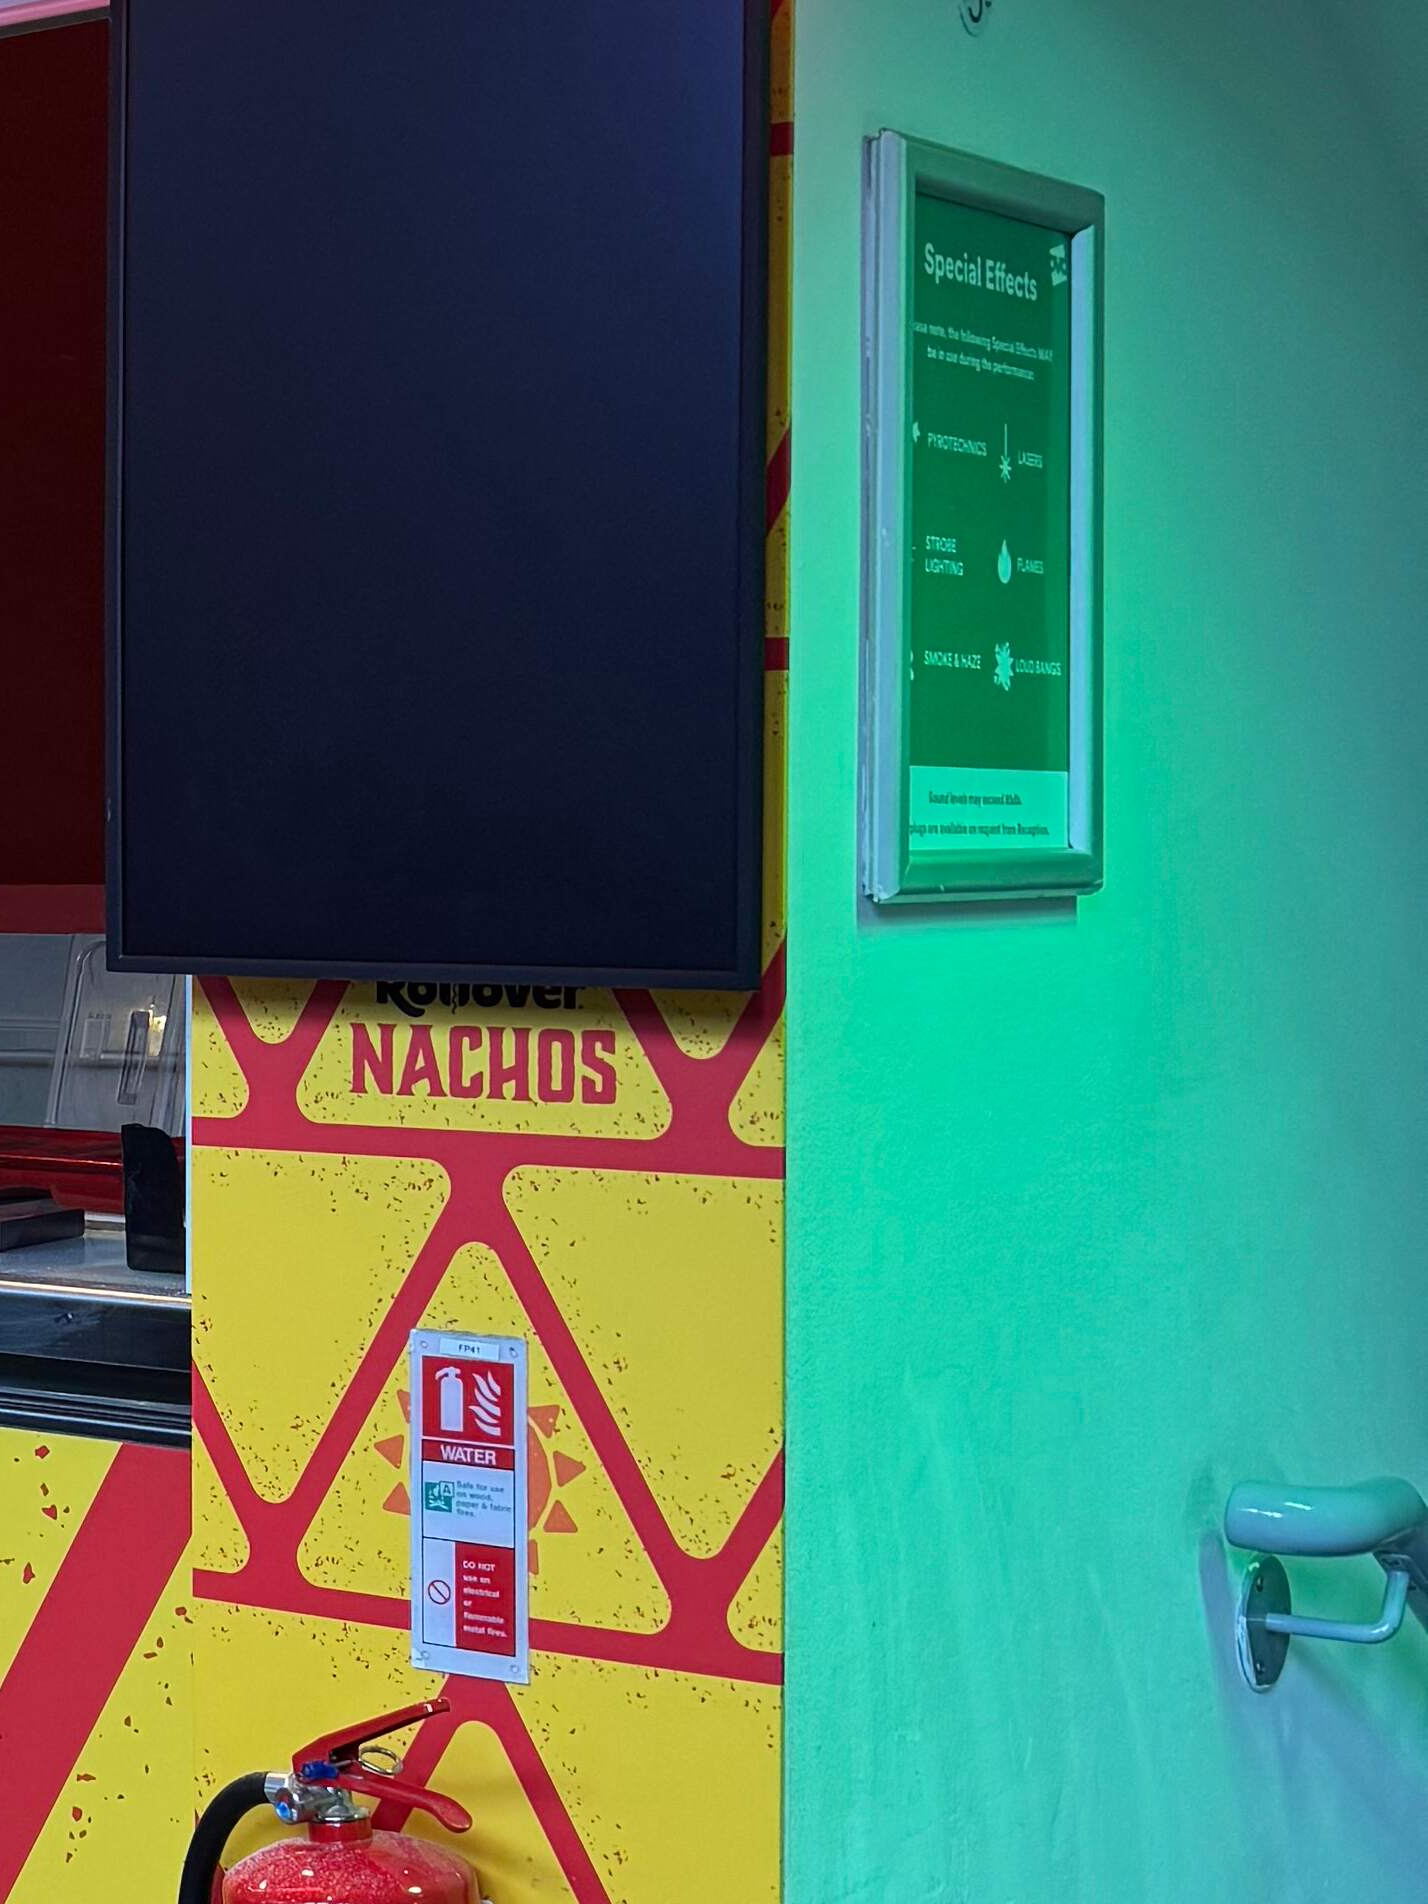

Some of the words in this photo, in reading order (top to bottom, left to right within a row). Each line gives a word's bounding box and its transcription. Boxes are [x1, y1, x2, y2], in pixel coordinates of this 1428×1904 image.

[924, 242, 982, 287] Special
[985, 259, 1037, 301] Effects
[927, 432, 987, 457] PYROTECHNICS
[926, 535, 956, 553] STROBE
[925, 558, 964, 576] LIGHTING
[924, 650, 953, 667] SMOKE
[961, 654, 981, 670] HAZE
[1015, 659, 1034, 674] LOUD
[1035, 660, 1062, 676] BANGS
[349, 1022, 617, 1105] NACHOS
[440, 1445, 496, 1466] WATER
[456, 1480, 473, 1490] Safe
[476, 1483, 487, 1492] for
[456, 1500, 479, 1509] paper
[463, 1560, 476, 1569] DO
[478, 1562, 496, 1572] NOT
